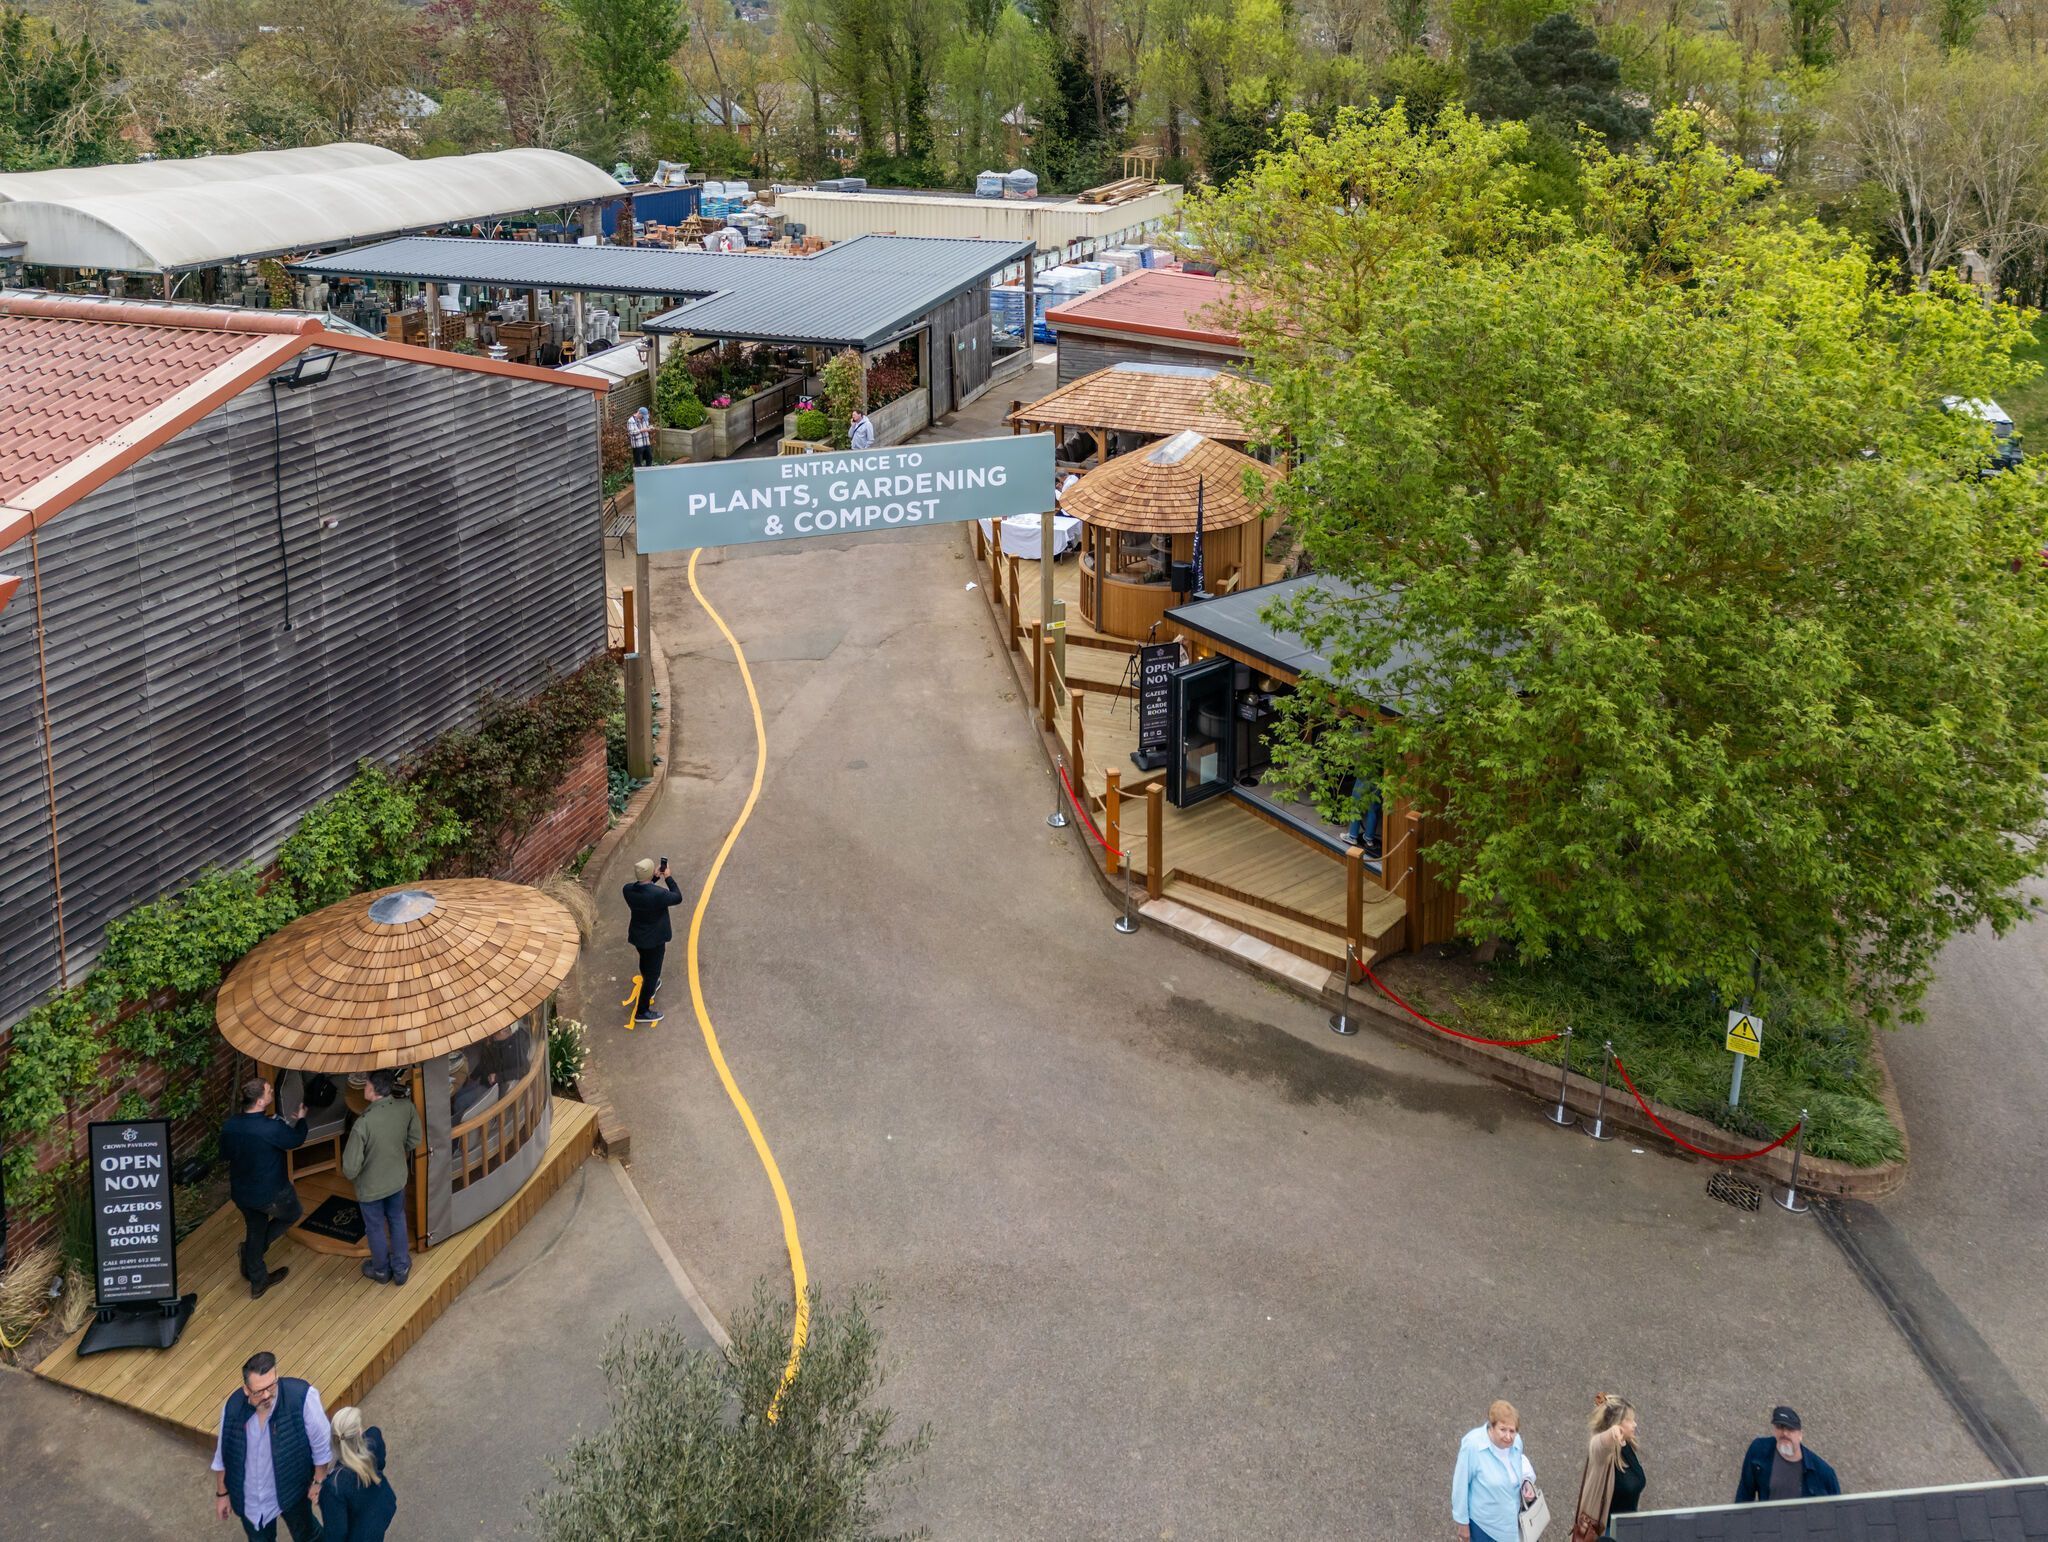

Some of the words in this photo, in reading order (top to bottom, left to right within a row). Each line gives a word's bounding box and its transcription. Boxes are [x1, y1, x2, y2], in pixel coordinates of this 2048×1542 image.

[780, 455, 891, 479] ENTRANCE
[895, 452, 923, 468] TO
[688, 484, 819, 516] PLANTS,
[828, 465, 1008, 502] GARDENING
[764, 514, 785, 536] &
[793, 499, 940, 534] COMPOST
[1145, 662, 1175, 674] OPEN
[100, 1155, 162, 1172] OPEN
[104, 1174, 160, 1192] NOW
[103, 1201, 162, 1214] GAZEBOS
[128, 1214, 139, 1223] &
[107, 1224, 160, 1236] GARDEN
[110, 1234, 158, 1247] ROOMS
